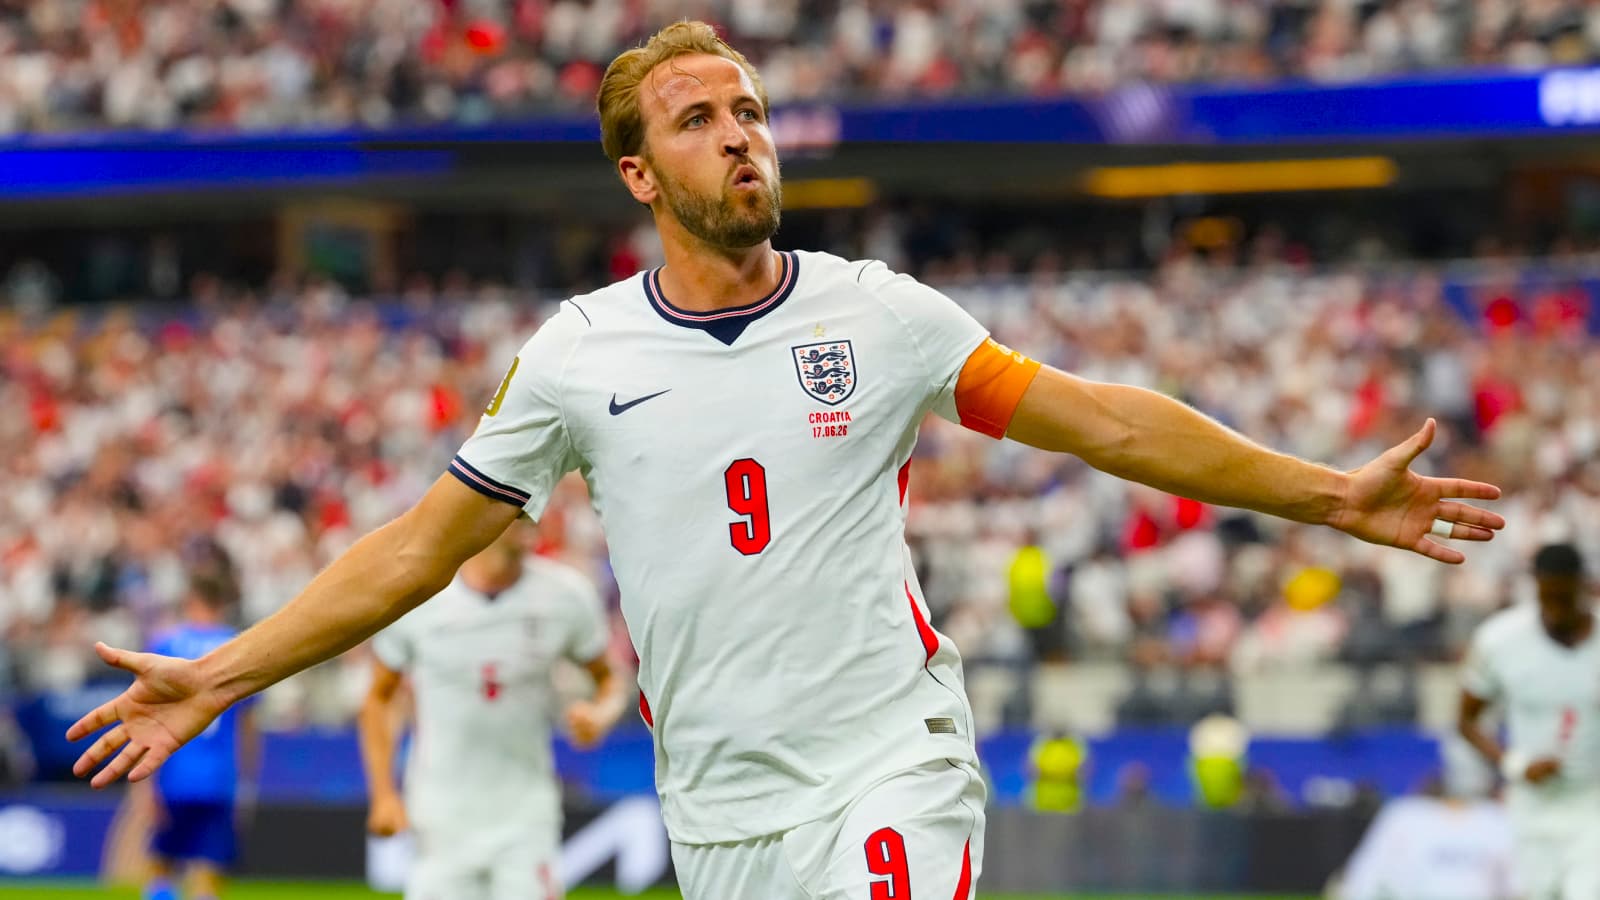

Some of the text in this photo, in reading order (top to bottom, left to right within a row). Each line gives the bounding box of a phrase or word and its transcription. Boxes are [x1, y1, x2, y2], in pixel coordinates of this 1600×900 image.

[808, 411, 852, 424] CROATIA
[812, 425, 848, 438] 17.06.26
[724, 458, 771, 555] 9
[865, 826, 911, 900] 9
